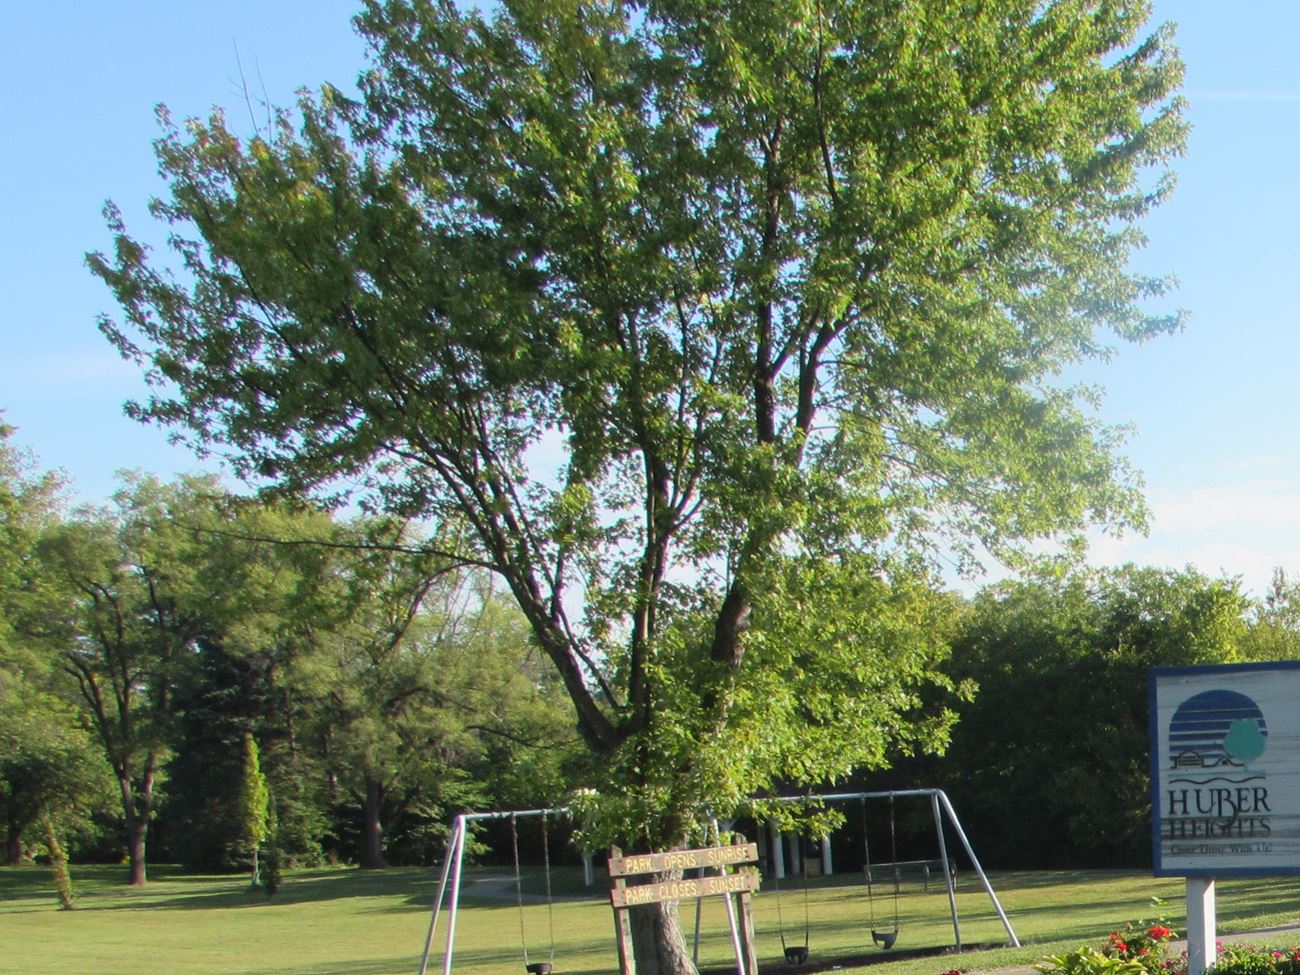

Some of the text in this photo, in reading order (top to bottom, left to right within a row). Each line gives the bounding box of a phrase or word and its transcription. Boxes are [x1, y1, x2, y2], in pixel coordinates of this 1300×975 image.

[1167, 787, 1271, 828] HUBER
[1167, 817, 1271, 841] HEIGHTS
[626, 847, 749, 873] PARK OPENS SUNRISE
[626, 876, 745, 904] PARK CLOSES SUNSET
